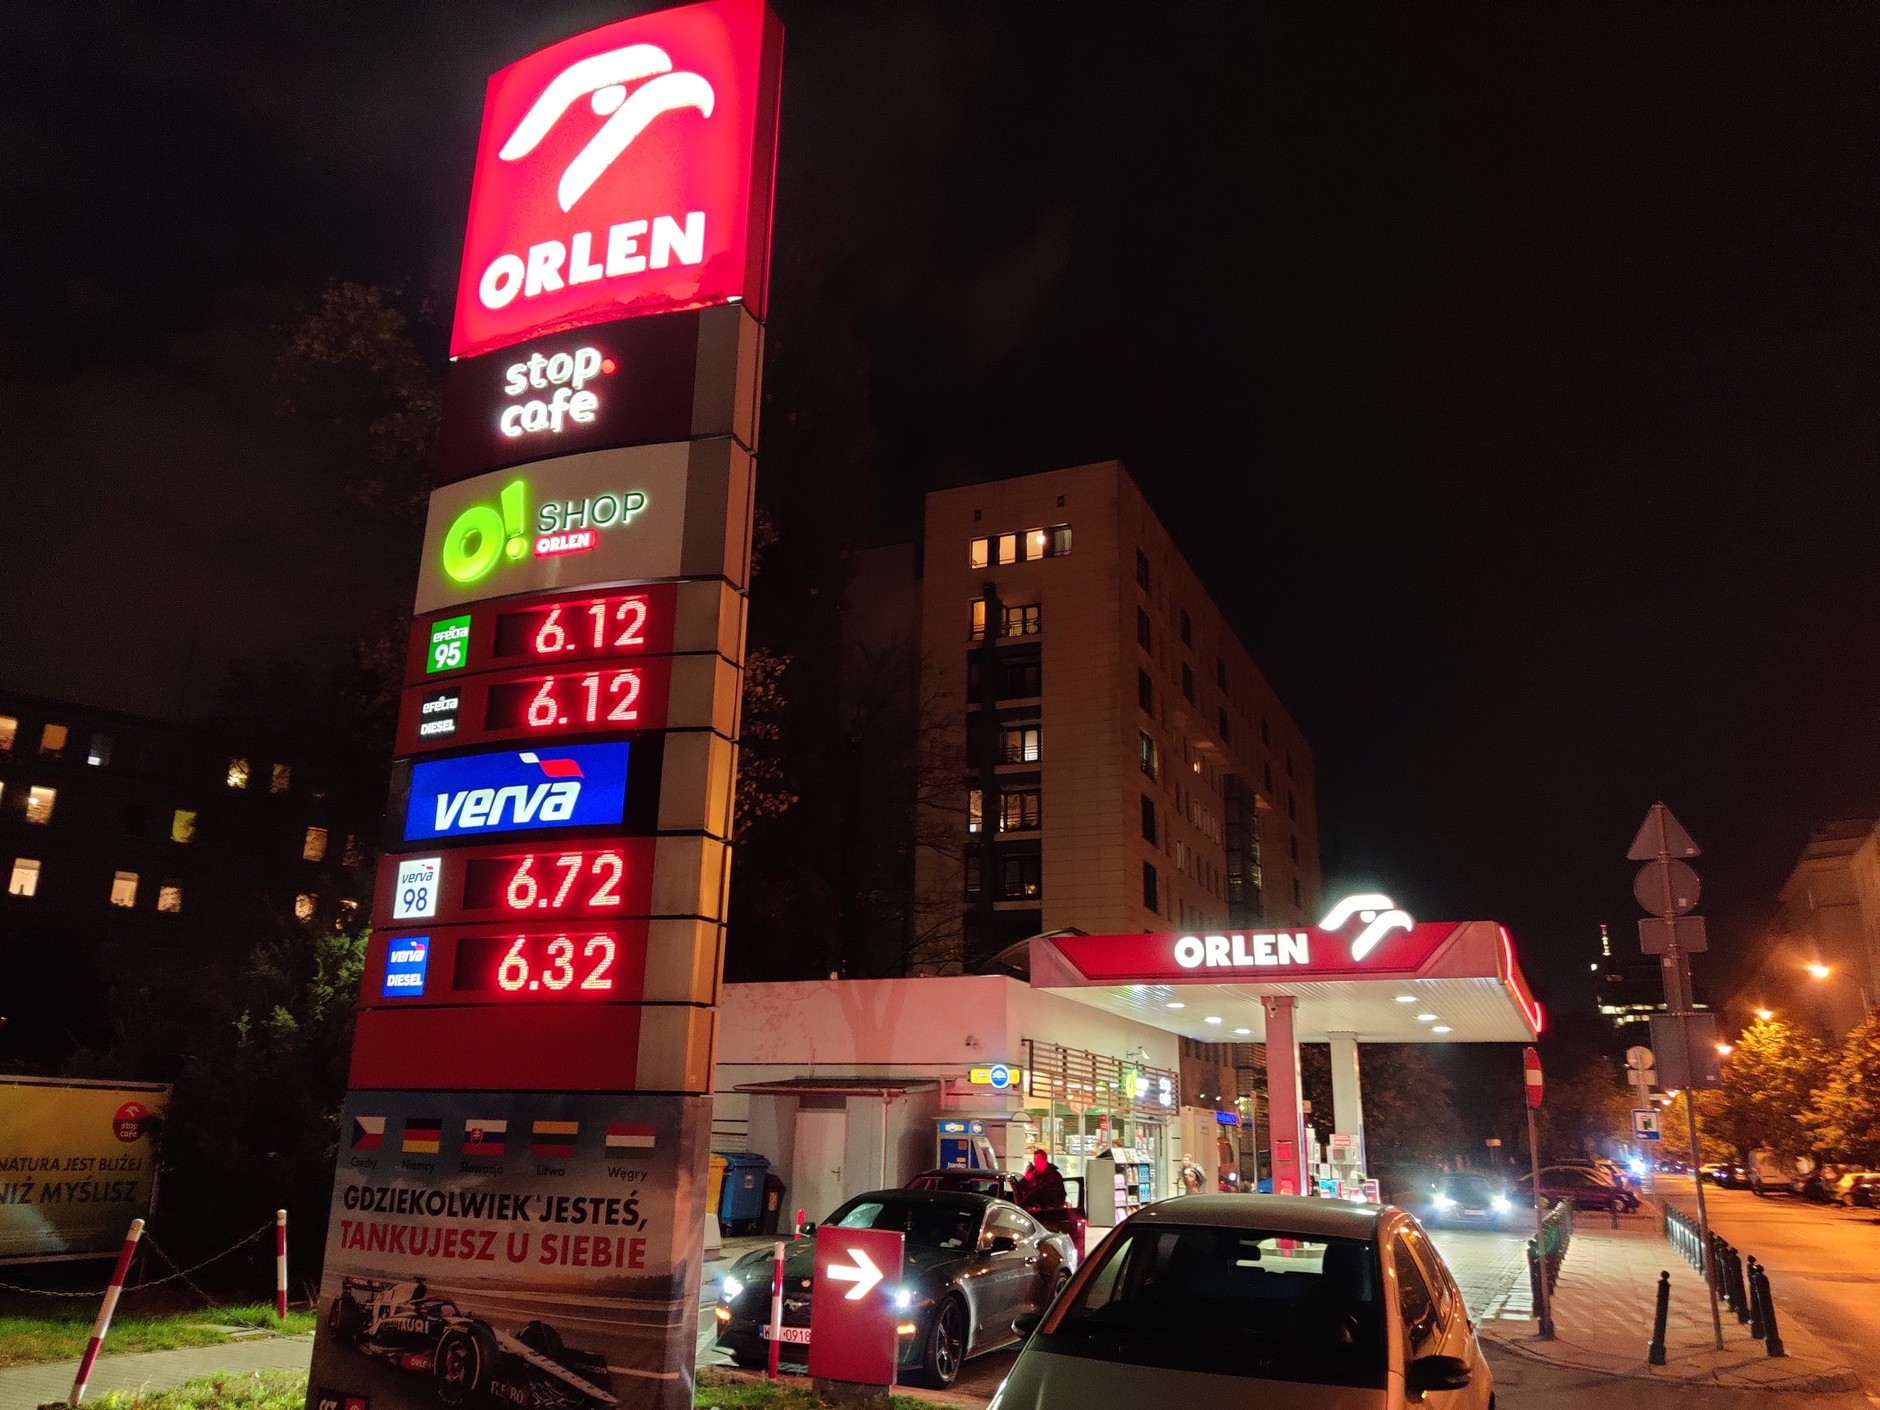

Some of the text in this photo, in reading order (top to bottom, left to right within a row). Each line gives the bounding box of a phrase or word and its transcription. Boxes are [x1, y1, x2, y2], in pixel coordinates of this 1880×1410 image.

[479, 211, 705, 309] ORLEN
[500, 387, 599, 437] cafe
[537, 492, 648, 532] SHOP
[443, 480, 528, 582] O!
[536, 532, 592, 553] ORLEN
[535, 599, 648, 654] 6.12
[434, 641, 461, 668] 95
[527, 671, 642, 727] 6.12
[420, 719, 455, 735] DIESEL
[435, 782, 582, 831] verva
[402, 871, 434, 884] verva
[507, 852, 623, 909] 6.72
[403, 887, 428, 913] 98
[391, 950, 425, 963] verva
[498, 934, 617, 991] 6.32
[1174, 933, 1309, 968] ORLEN
[386, 973, 423, 987] DIESEL
[0, 1157, 60, 1172] NATURA
[63, 1157, 96, 1172] JEST
[402, 1160, 435, 1175] Niemcy
[536, 1164, 566, 1177] Litwa
[608, 1166, 648, 1182] Węgry
[39, 1175, 138, 1203] MYŚLISZ
[344, 1185, 648, 1230] GDZIEKOLWIEK JESTEŚ,
[340, 1220, 647, 1270] TANKUJESZ U SIEBIE
